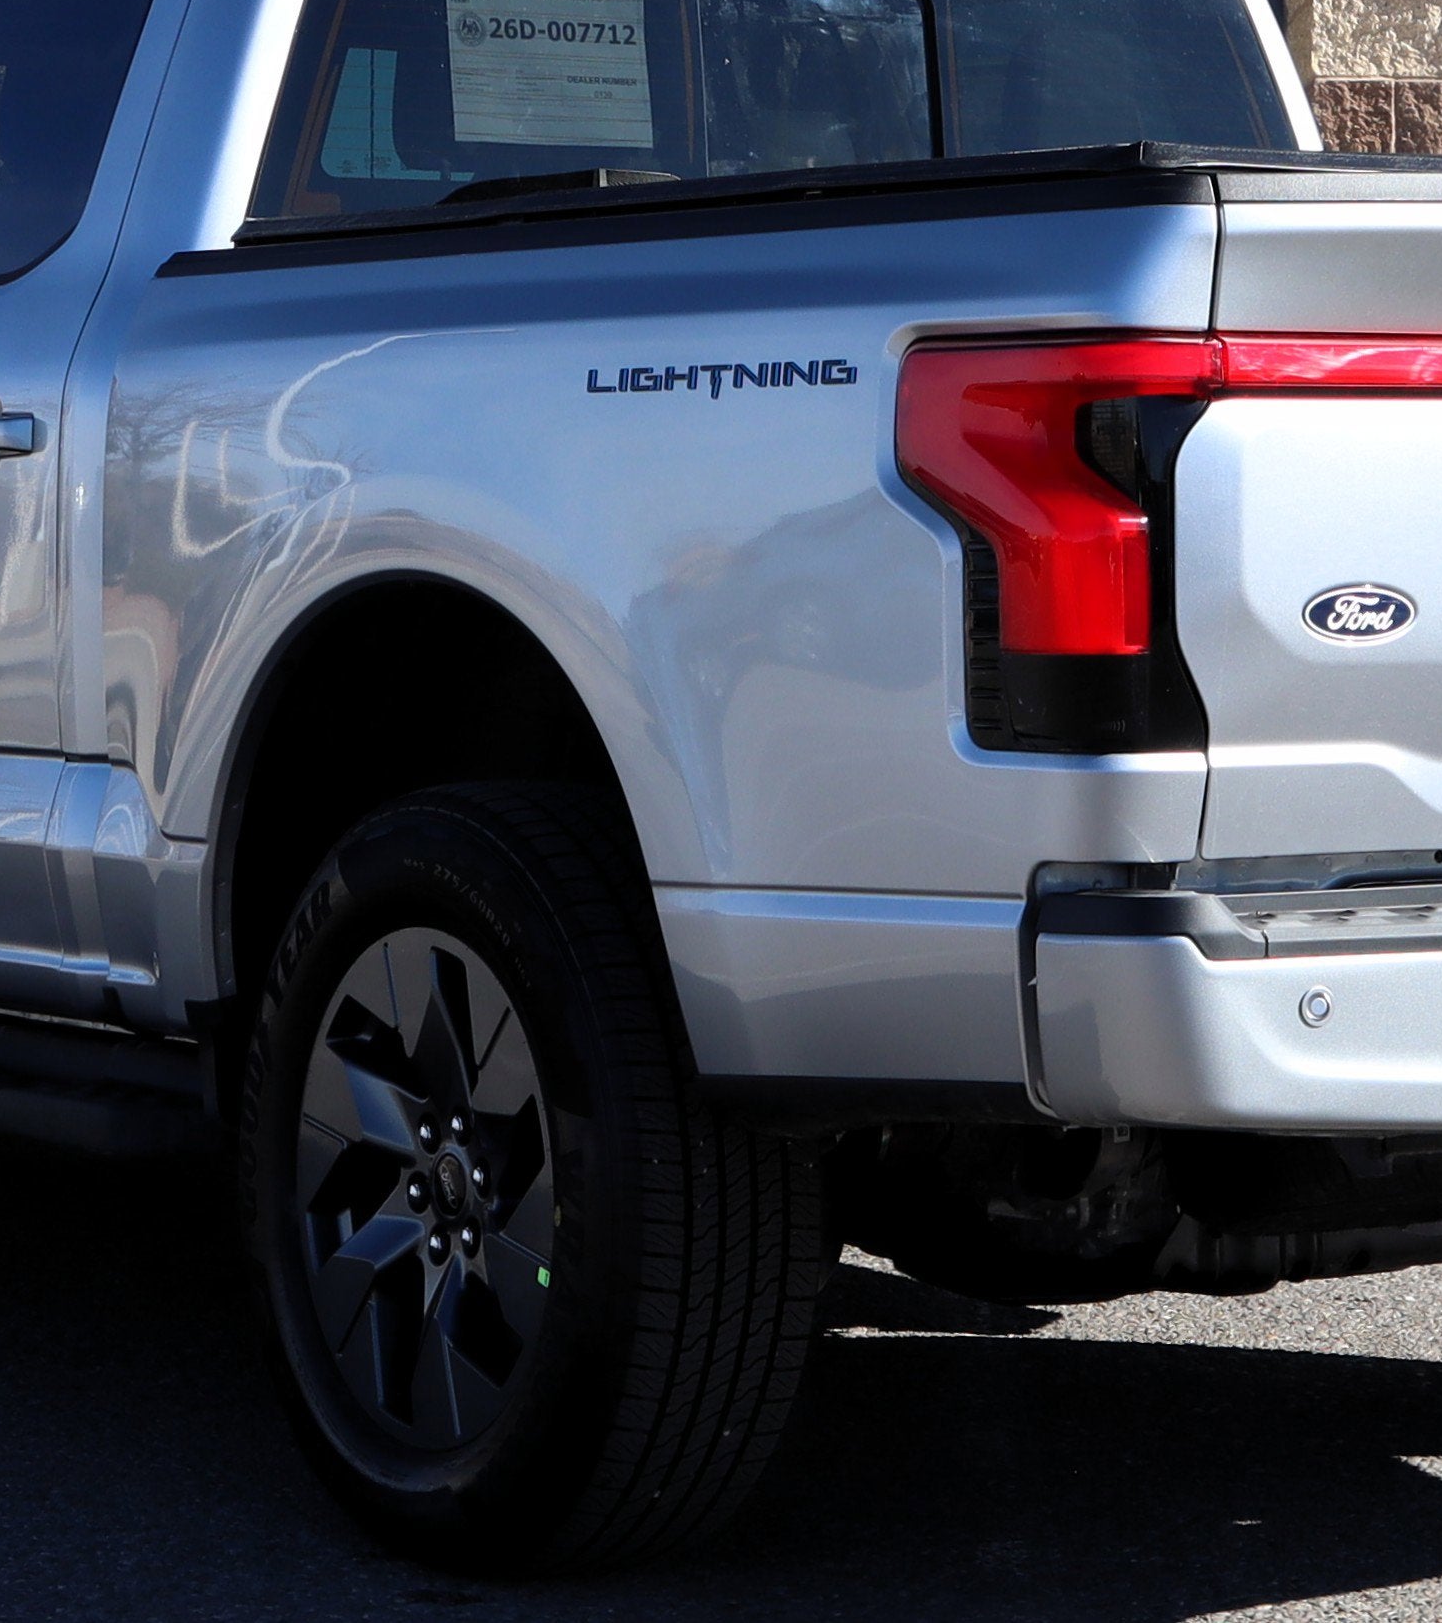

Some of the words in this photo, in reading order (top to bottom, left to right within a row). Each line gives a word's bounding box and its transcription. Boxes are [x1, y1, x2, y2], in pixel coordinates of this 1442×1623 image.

[488, 17, 637, 46] 26D-007712
[566, 75, 600, 85] DEALER
[602, 78, 638, 86] NUMBER
[586, 359, 858, 400] LIGHTNING
[1327, 595, 1396, 631] Ford
